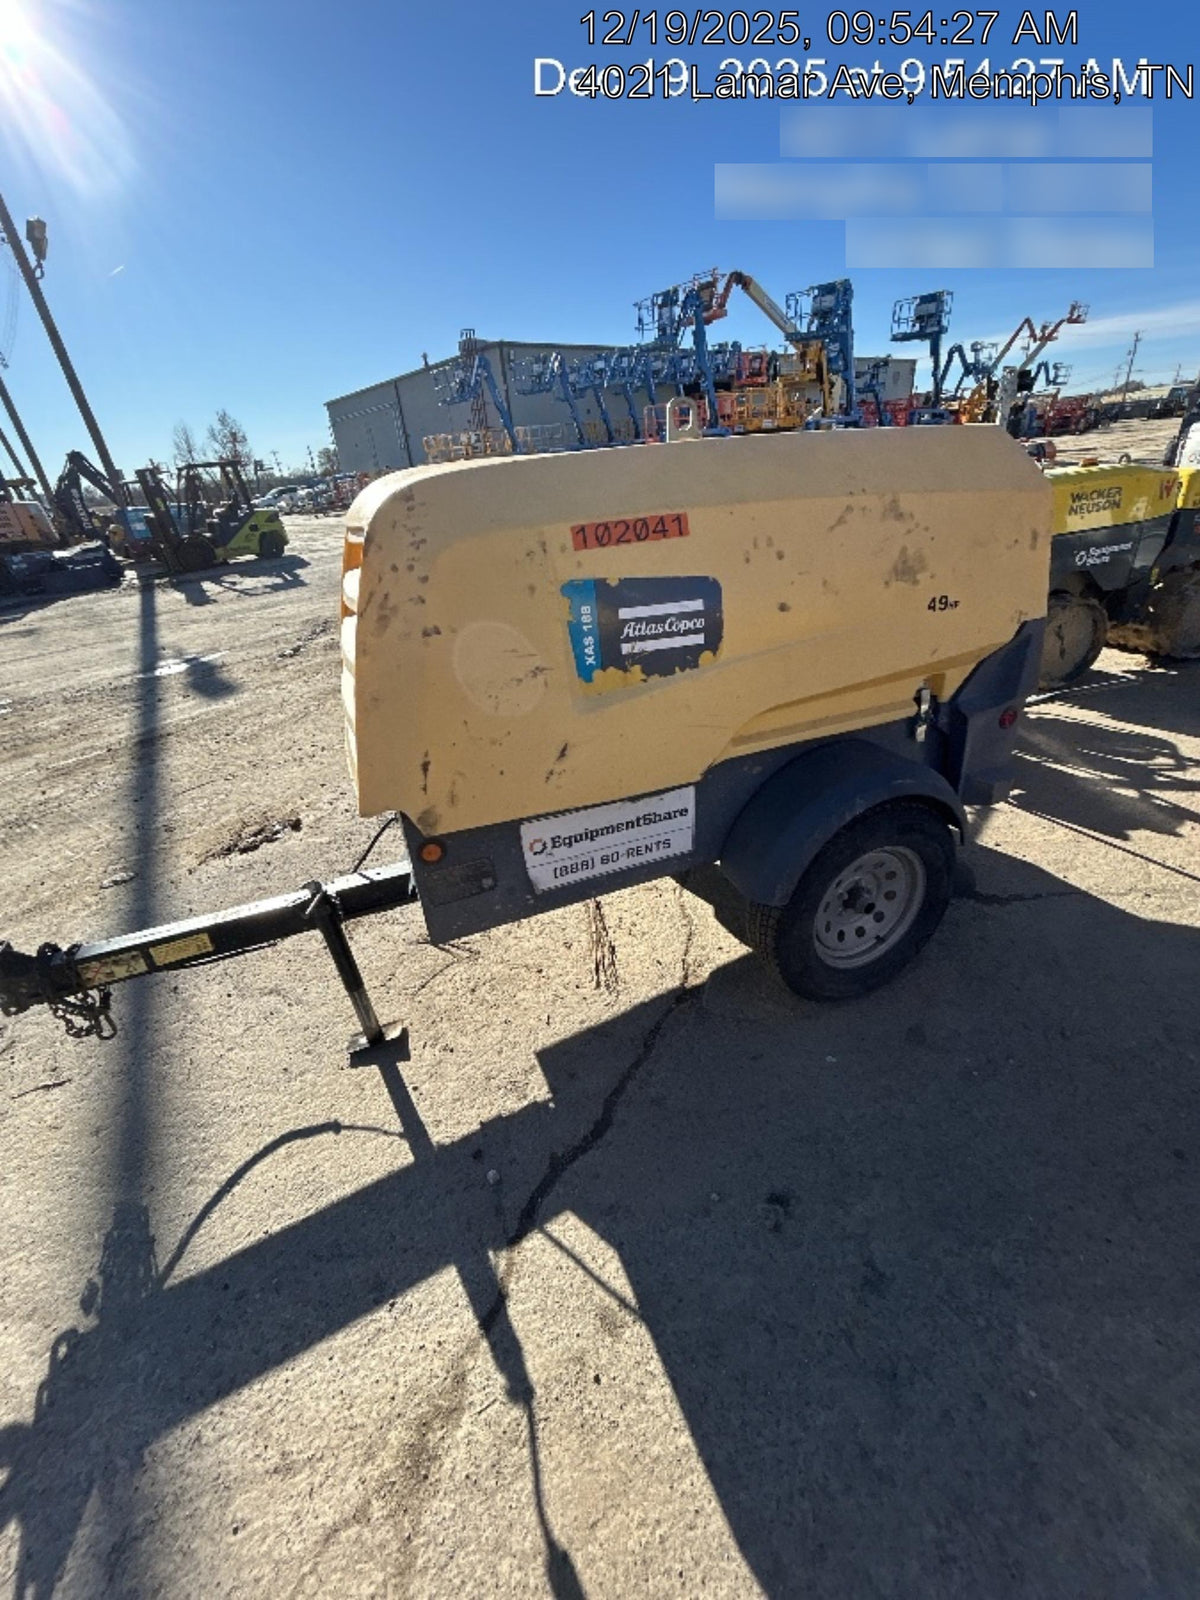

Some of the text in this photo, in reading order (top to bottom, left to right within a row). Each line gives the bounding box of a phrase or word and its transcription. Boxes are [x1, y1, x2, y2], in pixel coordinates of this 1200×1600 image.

[1068, 499, 1121, 516] NEUSON
[1070, 486, 1122, 503] WACKER
[575, 513, 685, 549] 102041
[582, 636, 596, 665] XAS
[550, 807, 689, 849] EquipmentShare
